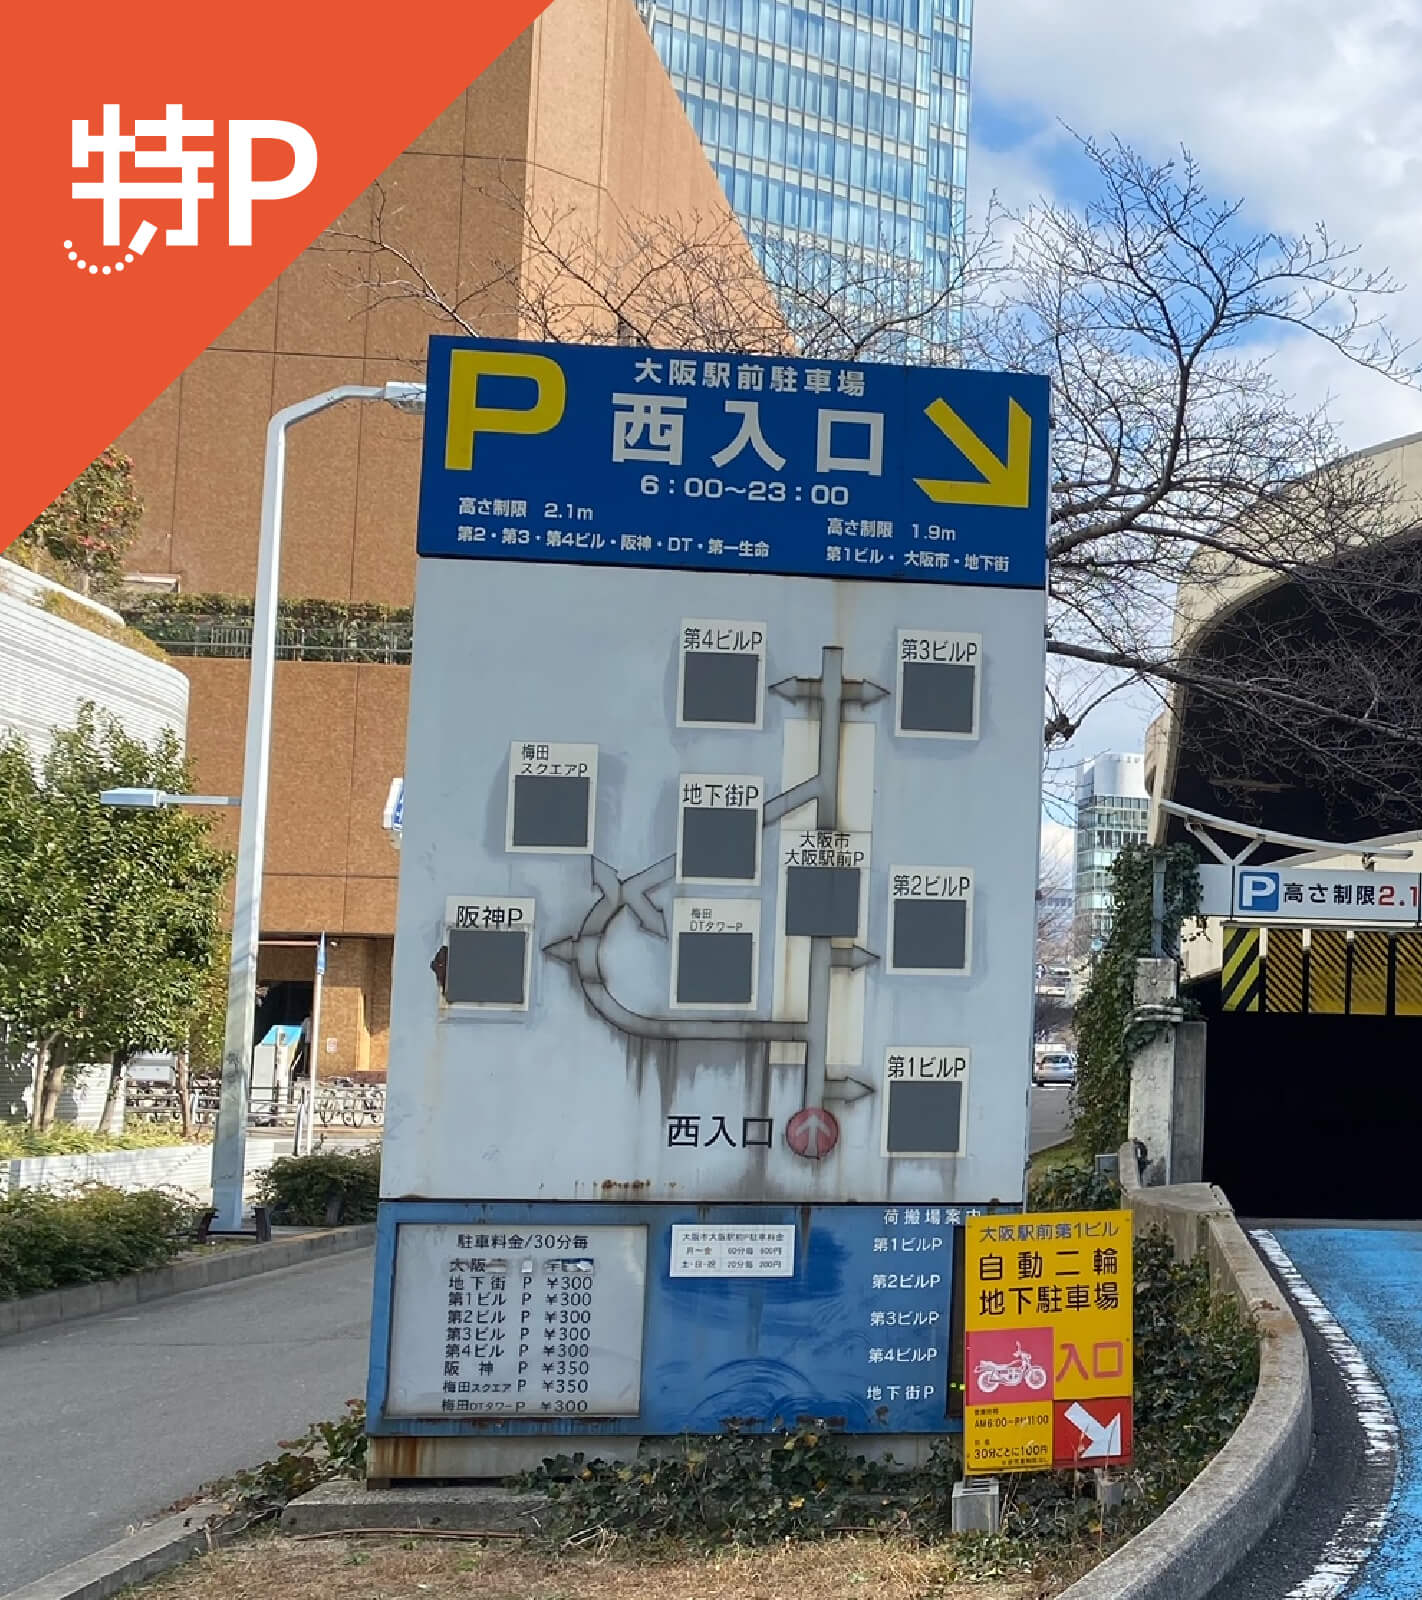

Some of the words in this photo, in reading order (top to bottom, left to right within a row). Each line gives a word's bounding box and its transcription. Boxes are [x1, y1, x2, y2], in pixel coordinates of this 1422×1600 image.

[634, 359, 866, 396] 大阪駅前駐車場
[444, 349, 566, 471] P
[611, 392, 886, 476] 西入口
[458, 498, 527, 519] 高さ制限
[544, 502, 593, 521] 2.1m
[827, 518, 894, 539] 高さ制限
[912, 523, 956, 542] 1.9m
[684, 628, 762, 650] 第4ビルP
[901, 639, 977, 662] 第3ビルP
[522, 744, 549, 761] 梅田
[521, 763, 587, 777] スクエアP
[683, 784, 758, 807] 地下街P
[800, 831, 851, 849] 大阪市
[785, 849, 864, 867] 大阪駅前P
[893, 875, 970, 896] 第2ビルP
[1242, 876, 1274, 906] P
[456, 906, 523, 929] 阪神P
[888, 1055, 966, 1078] 第1ビルP
[667, 1116, 774, 1149] 西入口
[979, 1221, 1119, 1243] 大阪駅前第1ビル
[458, 1234, 588, 1250] 駐車料金/30分毎
[873, 1237, 942, 1252] 第1ビルP
[979, 1248, 1118, 1281] 自動二輪
[449, 1277, 505, 1290] 地下街
[523, 1277, 531, 1289] P
[872, 1274, 941, 1289] 第2ビルP
[449, 1293, 506, 1306] 第1ビル
[522, 1294, 531, 1305] P
[979, 1282, 1119, 1315] 地下駐車場
[448, 1310, 505, 1324] 第2ビル
[521, 1311, 530, 1322] P
[870, 1311, 940, 1326] 第3ビルP
[447, 1328, 505, 1341] 第3ビル
[520, 1328, 529, 1340] P
[446, 1344, 504, 1358] 第4ビル
[519, 1345, 528, 1356] P
[868, 1348, 937, 1363] 第4ビルP
[445, 1361, 493, 1375] 阪神
[519, 1362, 528, 1374] P
[1056, 1341, 1123, 1382] 入口
[443, 1382, 511, 1393] 梅田スクエア
[518, 1380, 526, 1392] P
[867, 1385, 934, 1401] 地下街P
[442, 1399, 512, 1412] 梅田DTタワー
[516, 1402, 525, 1412] P
